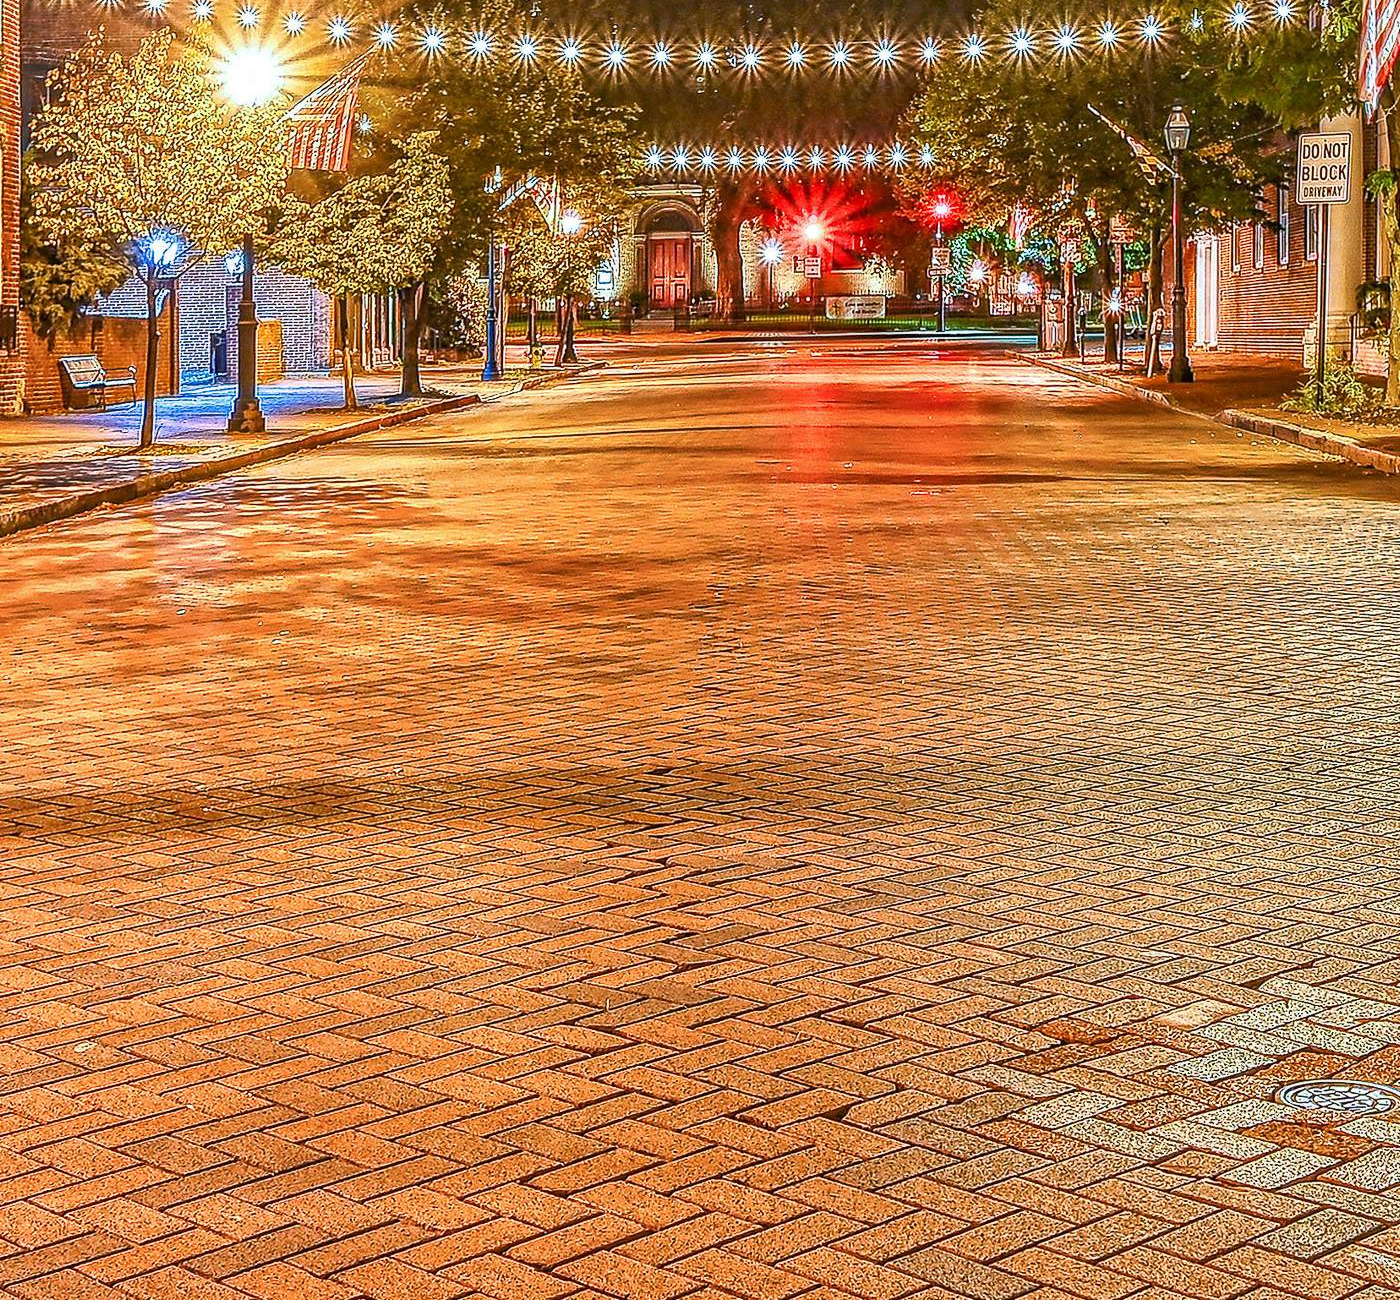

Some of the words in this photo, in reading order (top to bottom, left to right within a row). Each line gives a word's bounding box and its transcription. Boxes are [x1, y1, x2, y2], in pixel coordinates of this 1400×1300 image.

[1303, 143, 1319, 159] DO
[1323, 142, 1348, 159] NOT
[1302, 165, 1347, 181] BLOCK
[1303, 186, 1343, 198] DRIVEWAY
